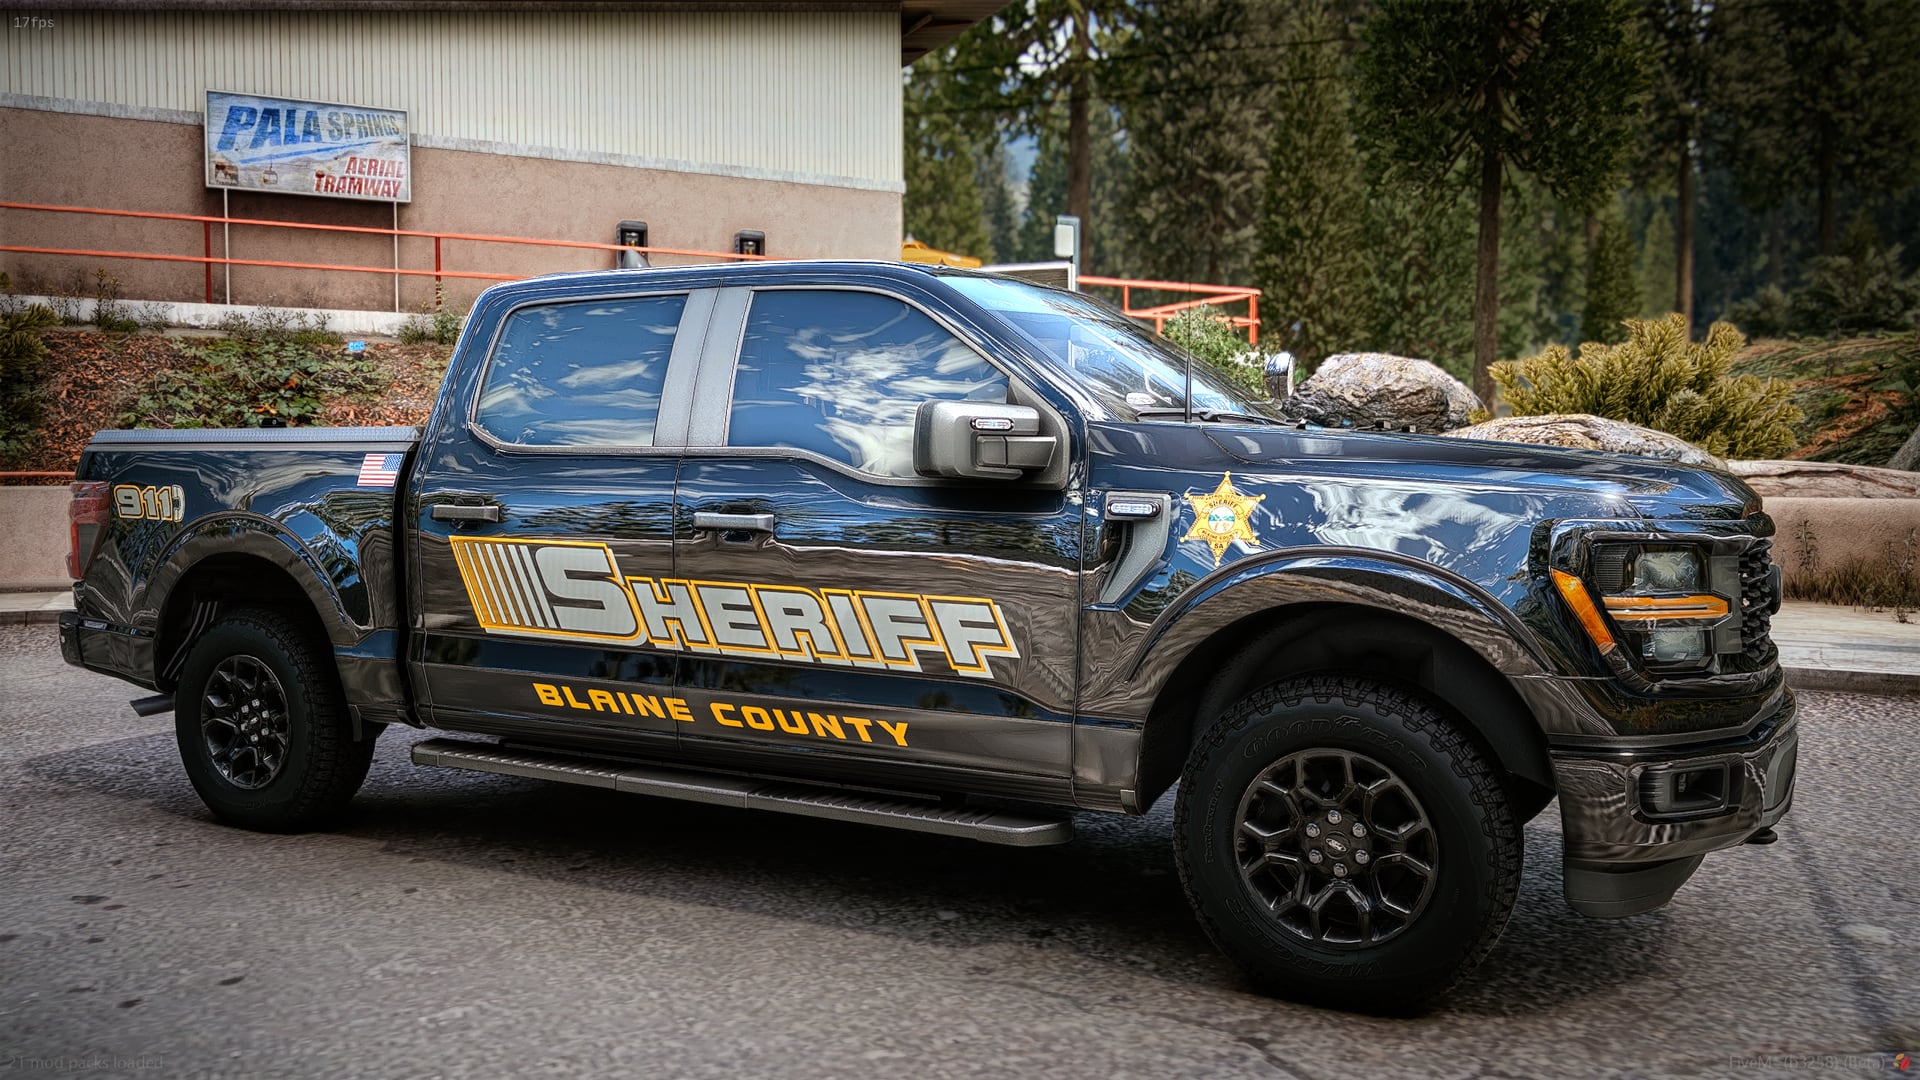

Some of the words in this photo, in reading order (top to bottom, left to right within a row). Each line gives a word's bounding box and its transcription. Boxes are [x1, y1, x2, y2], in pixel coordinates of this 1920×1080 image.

[216, 105, 323, 152] PALA
[327, 111, 401, 142] SPRINGS
[314, 171, 401, 198] TRAMWAY
[345, 156, 405, 179] AERIAL
[114, 484, 173, 520] 911
[533, 536, 1020, 678] SHERIFF
[532, 682, 695, 722] BLAINE
[709, 702, 909, 747] COUNTY
